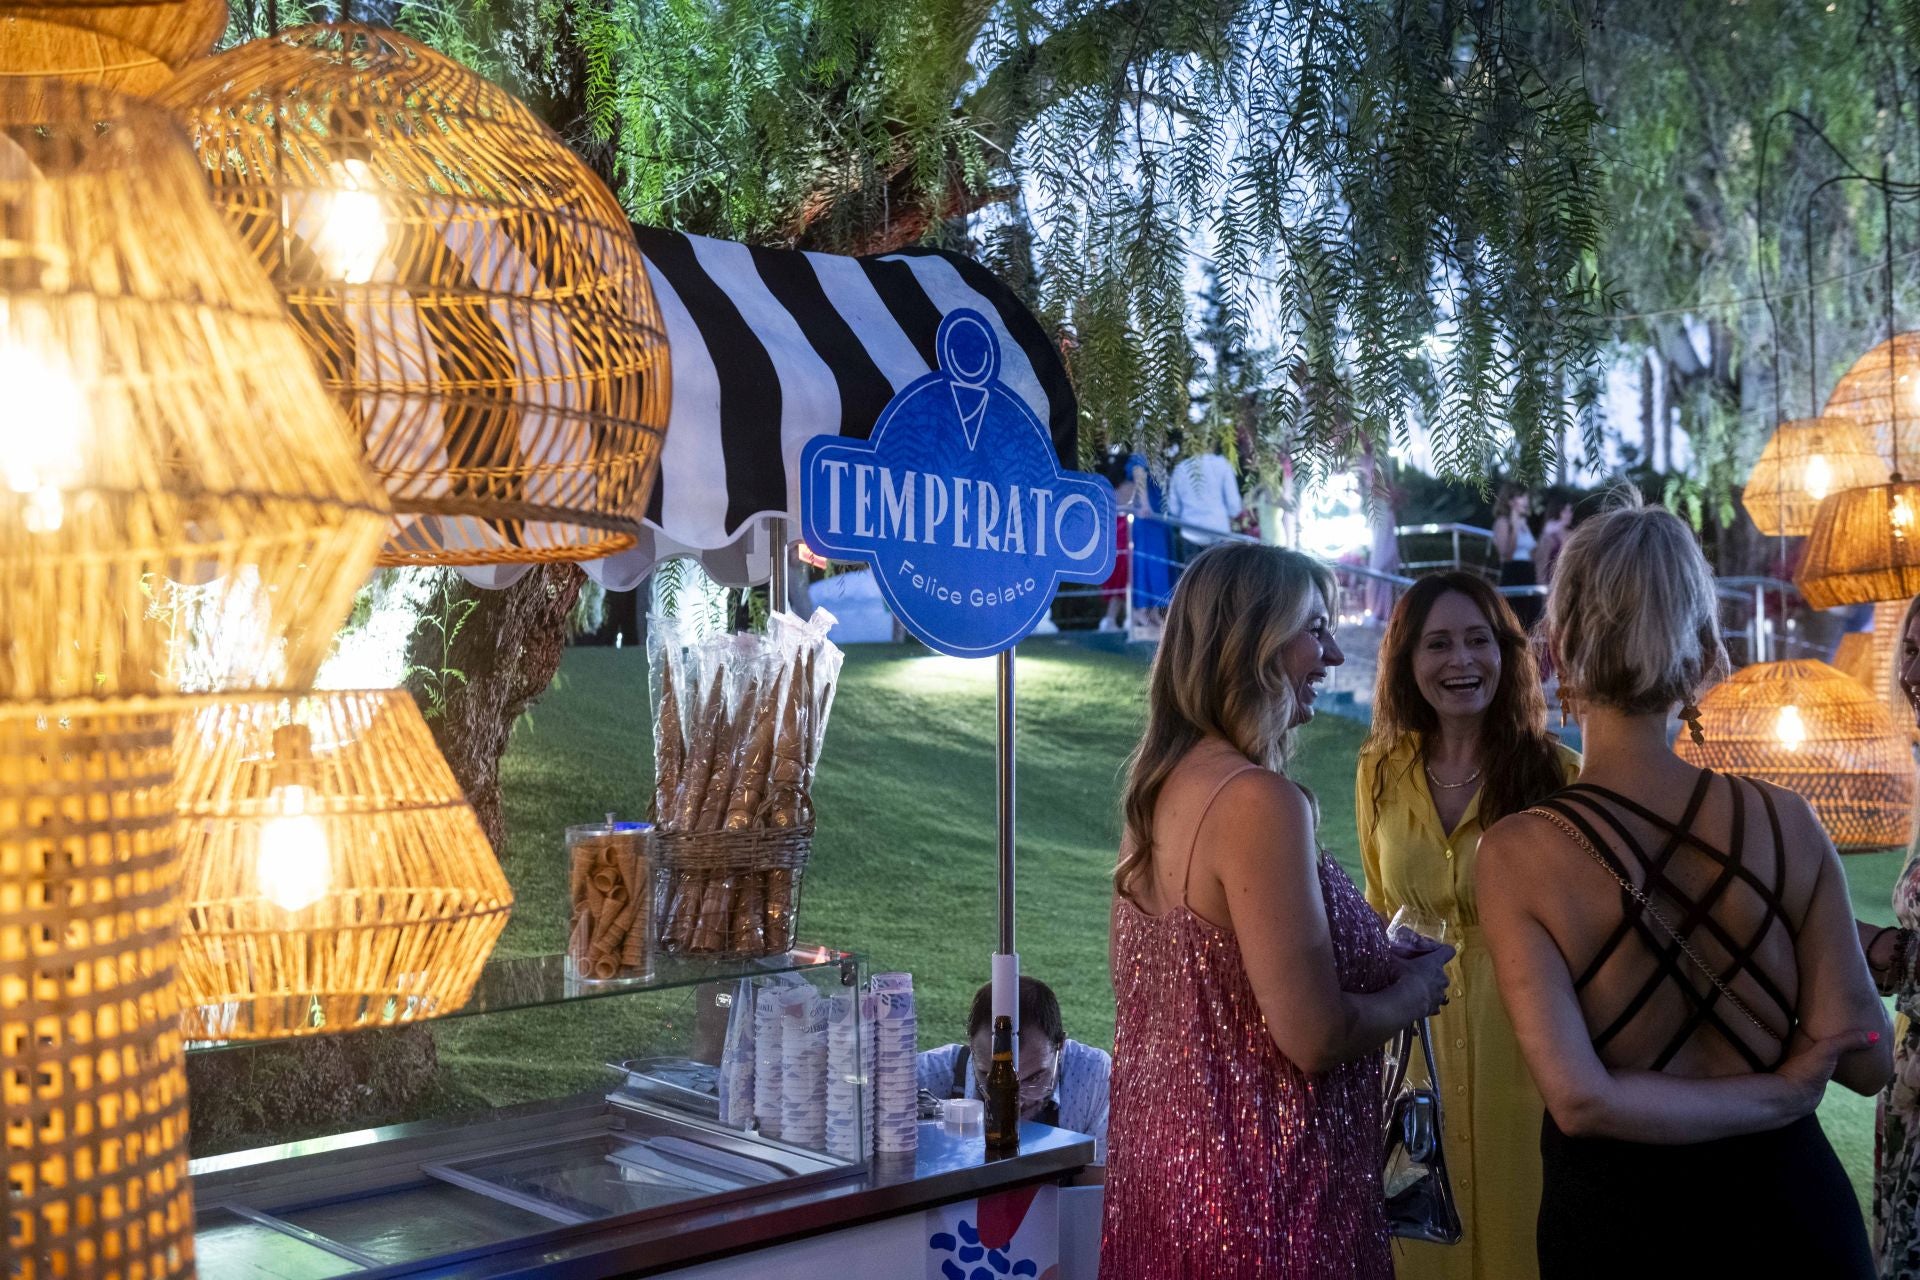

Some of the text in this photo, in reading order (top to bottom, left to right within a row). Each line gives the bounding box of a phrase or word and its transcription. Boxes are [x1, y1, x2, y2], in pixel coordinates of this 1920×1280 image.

[821, 459, 1100, 560] TEMPERATO
[898, 559, 1035, 607] Felice Gelato
